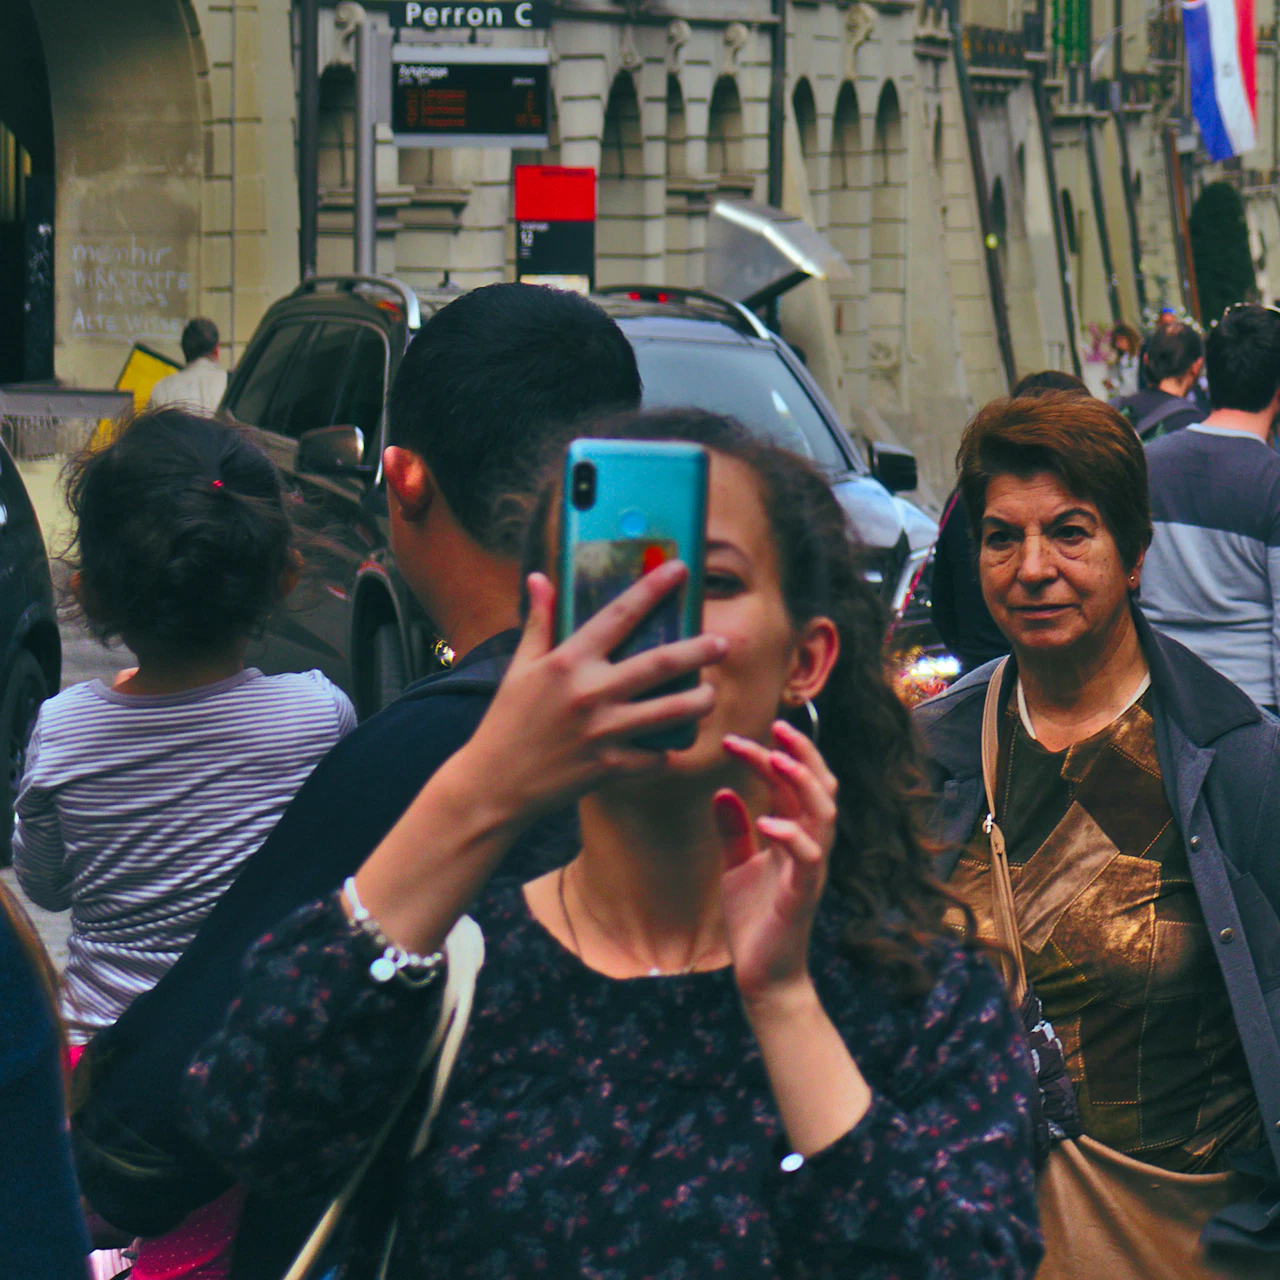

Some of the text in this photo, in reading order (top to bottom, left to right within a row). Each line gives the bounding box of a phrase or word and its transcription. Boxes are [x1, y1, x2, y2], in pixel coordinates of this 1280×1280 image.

[406, 2, 532, 27] Perron C
[72, 232, 174, 266] menhir
